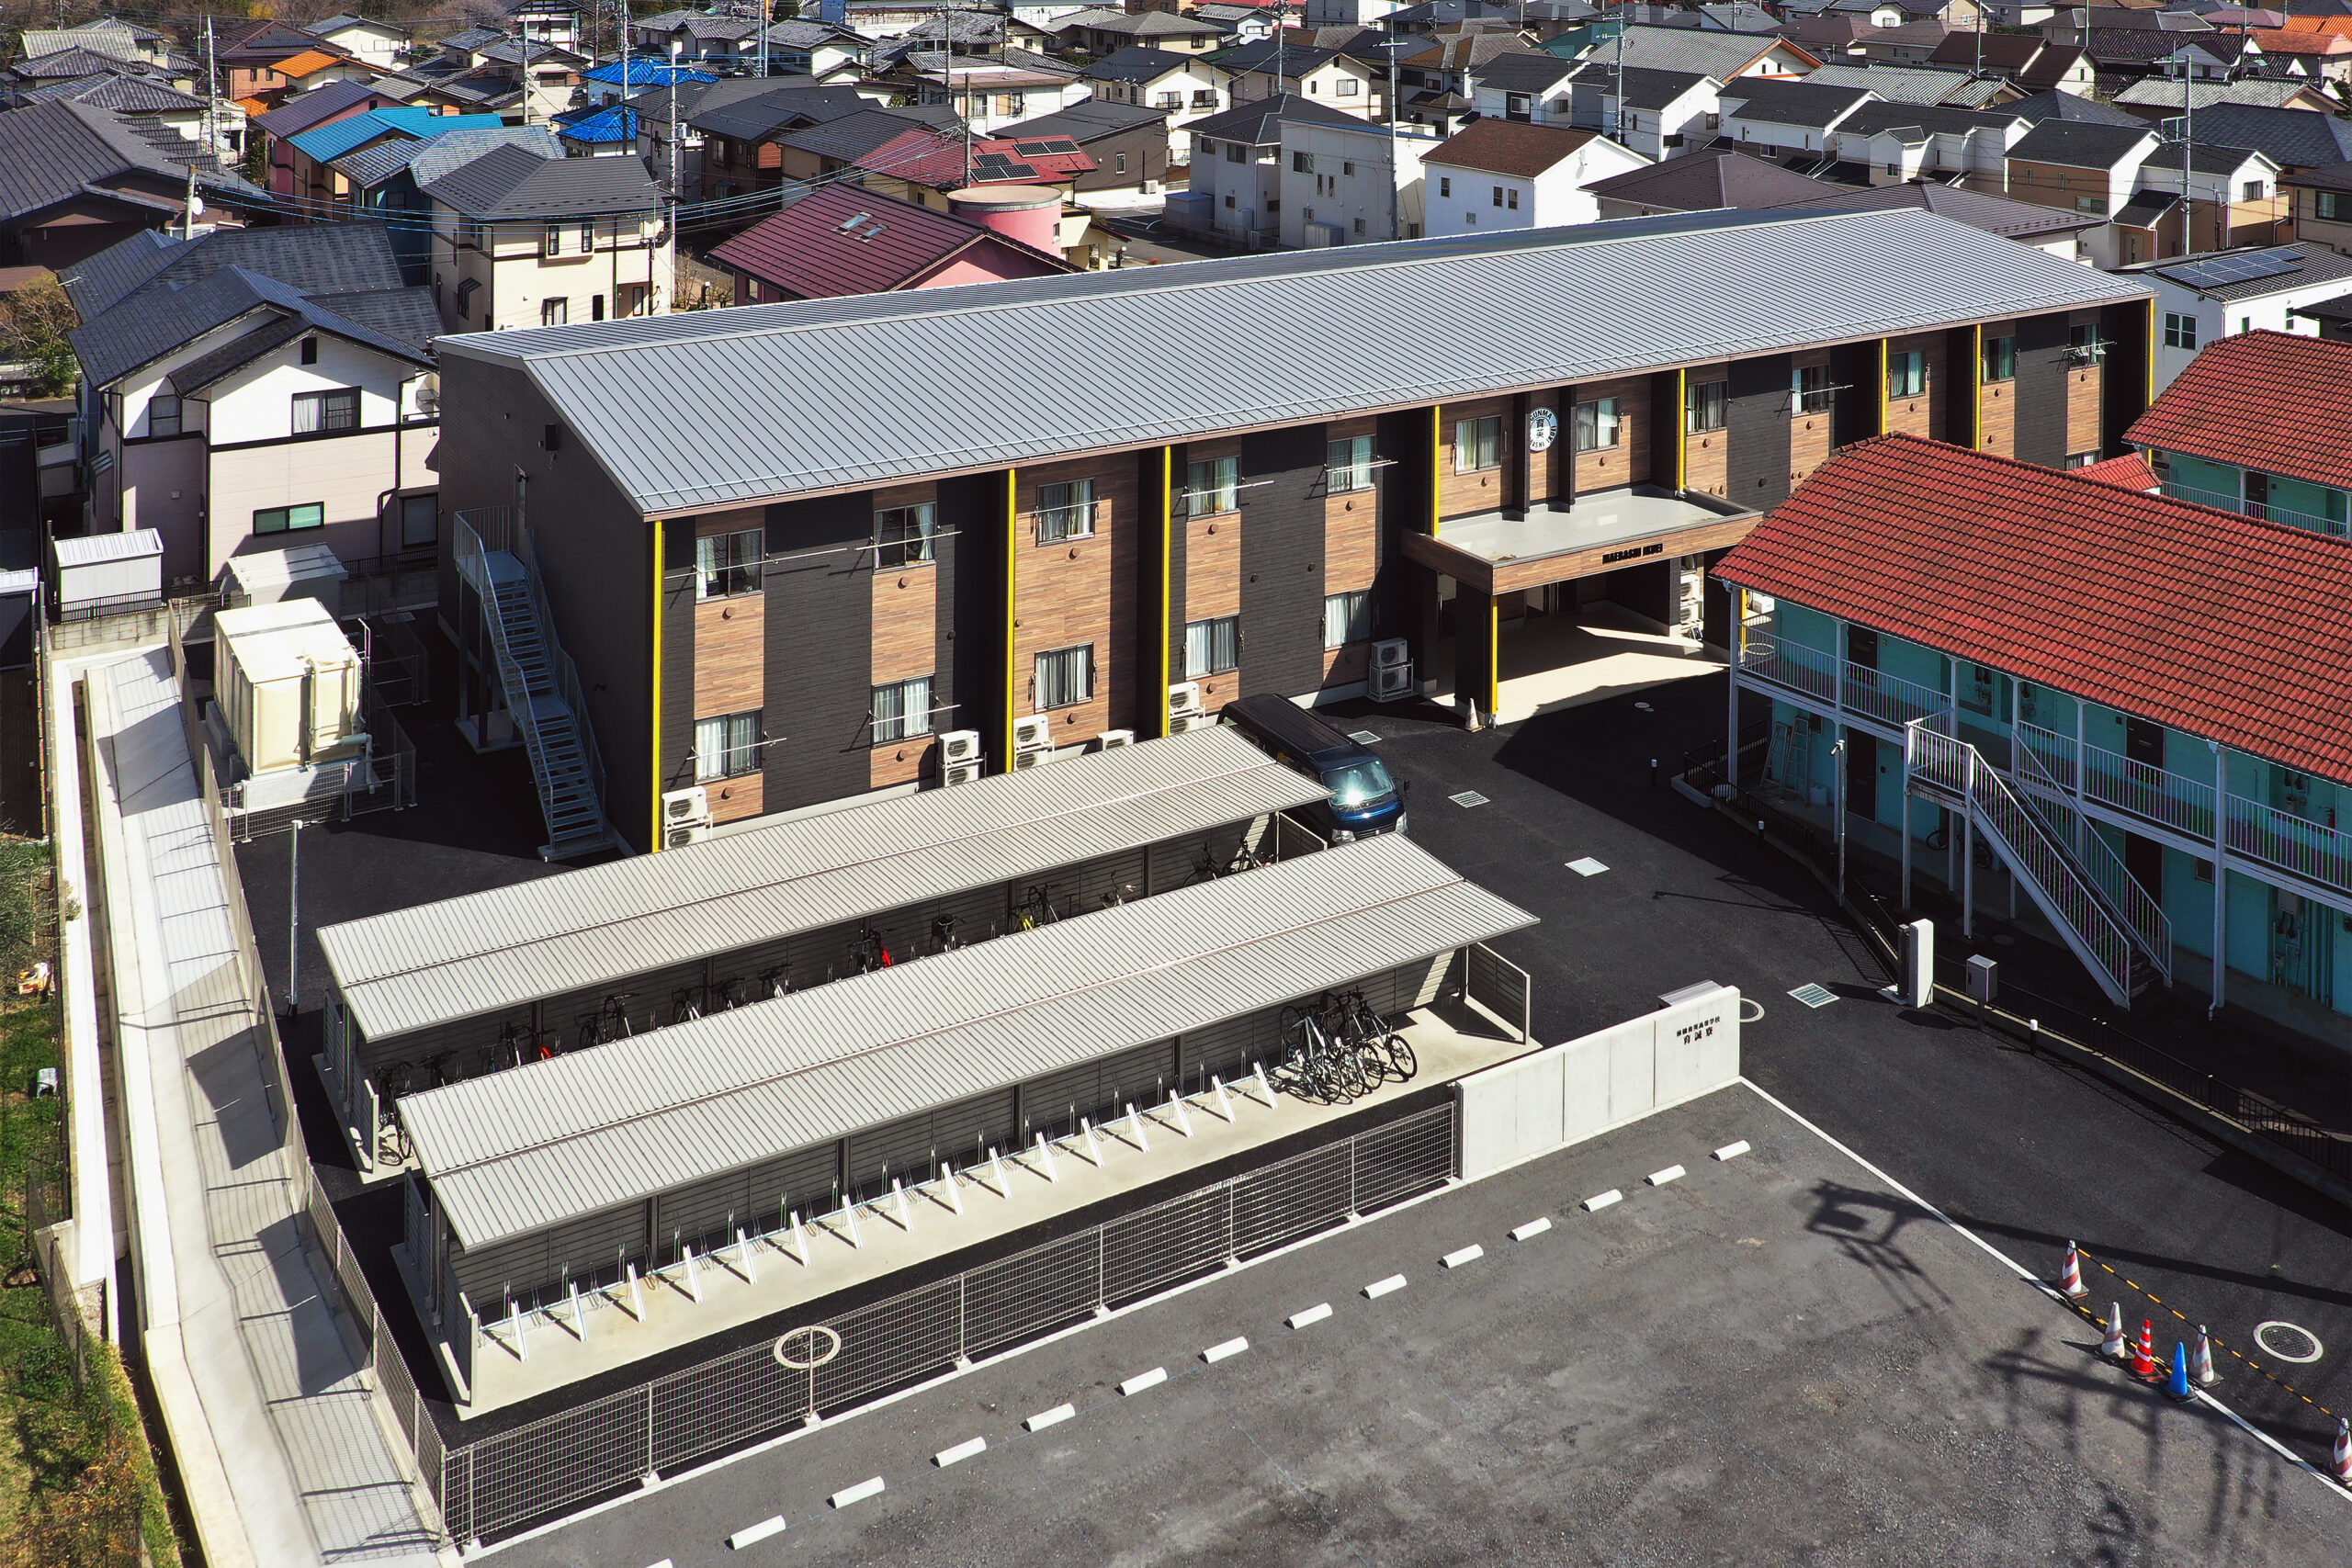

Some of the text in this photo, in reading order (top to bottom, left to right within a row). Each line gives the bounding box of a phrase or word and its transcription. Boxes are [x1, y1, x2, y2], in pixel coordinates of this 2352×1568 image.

[1530, 409, 1552, 421] GUNMA
[1536, 419, 1544, 439] 育英
[1602, 547, 1642, 564] MAEBASHI
